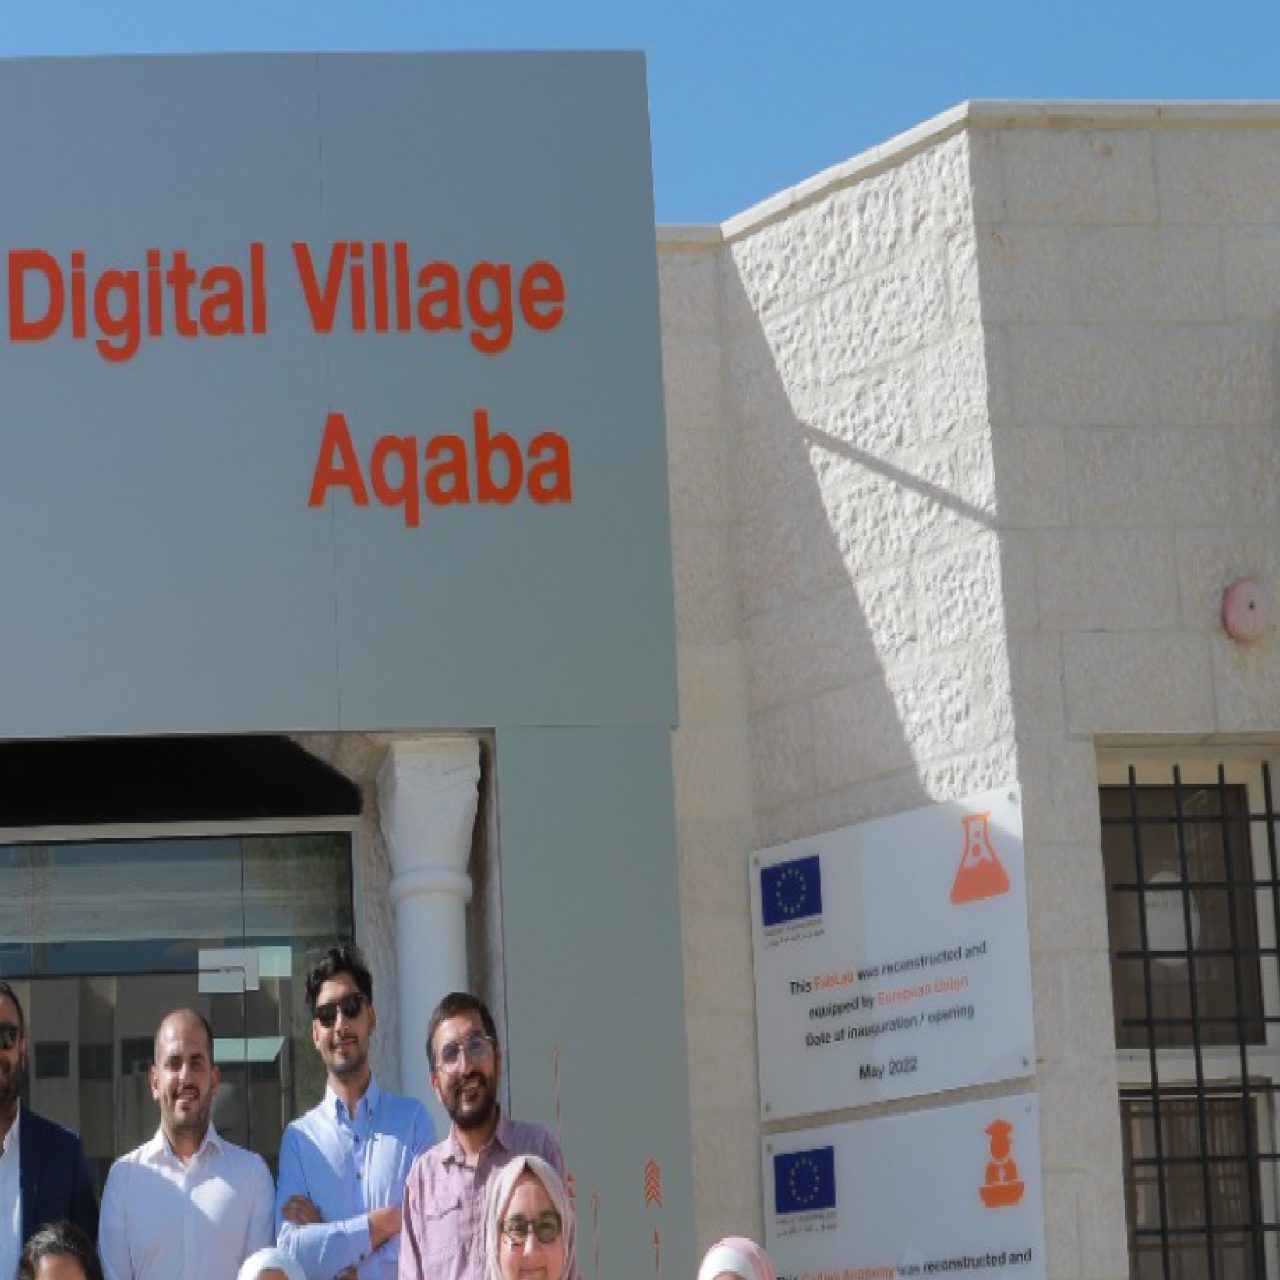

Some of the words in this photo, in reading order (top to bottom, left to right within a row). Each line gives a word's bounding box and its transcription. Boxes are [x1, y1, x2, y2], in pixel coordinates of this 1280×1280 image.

[7, 242, 268, 363] Digital
[292, 240, 566, 354] Village
[308, 408, 573, 529] Aqaba
[789, 980, 812, 995] This
[857, 965, 880, 981] was
[881, 945, 962, 976] reconstructed
[964, 940, 987, 959] and
[808, 996, 859, 1020] equipped
[862, 995, 875, 1011] by
[877, 980, 932, 1006] European
[933, 975, 969, 995] Union
[805, 1030, 831, 1047] Date
[834, 1027, 845, 1042] of
[847, 1015, 918, 1041] inauguration
[927, 1003, 975, 1025] opening
[859, 1063, 885, 1081] May
[888, 1056, 918, 1077] 2022
[896, 1263, 921, 1276] was
[923, 1251, 1007, 1274] reconstructed
[1008, 1248, 1032, 1263] and
